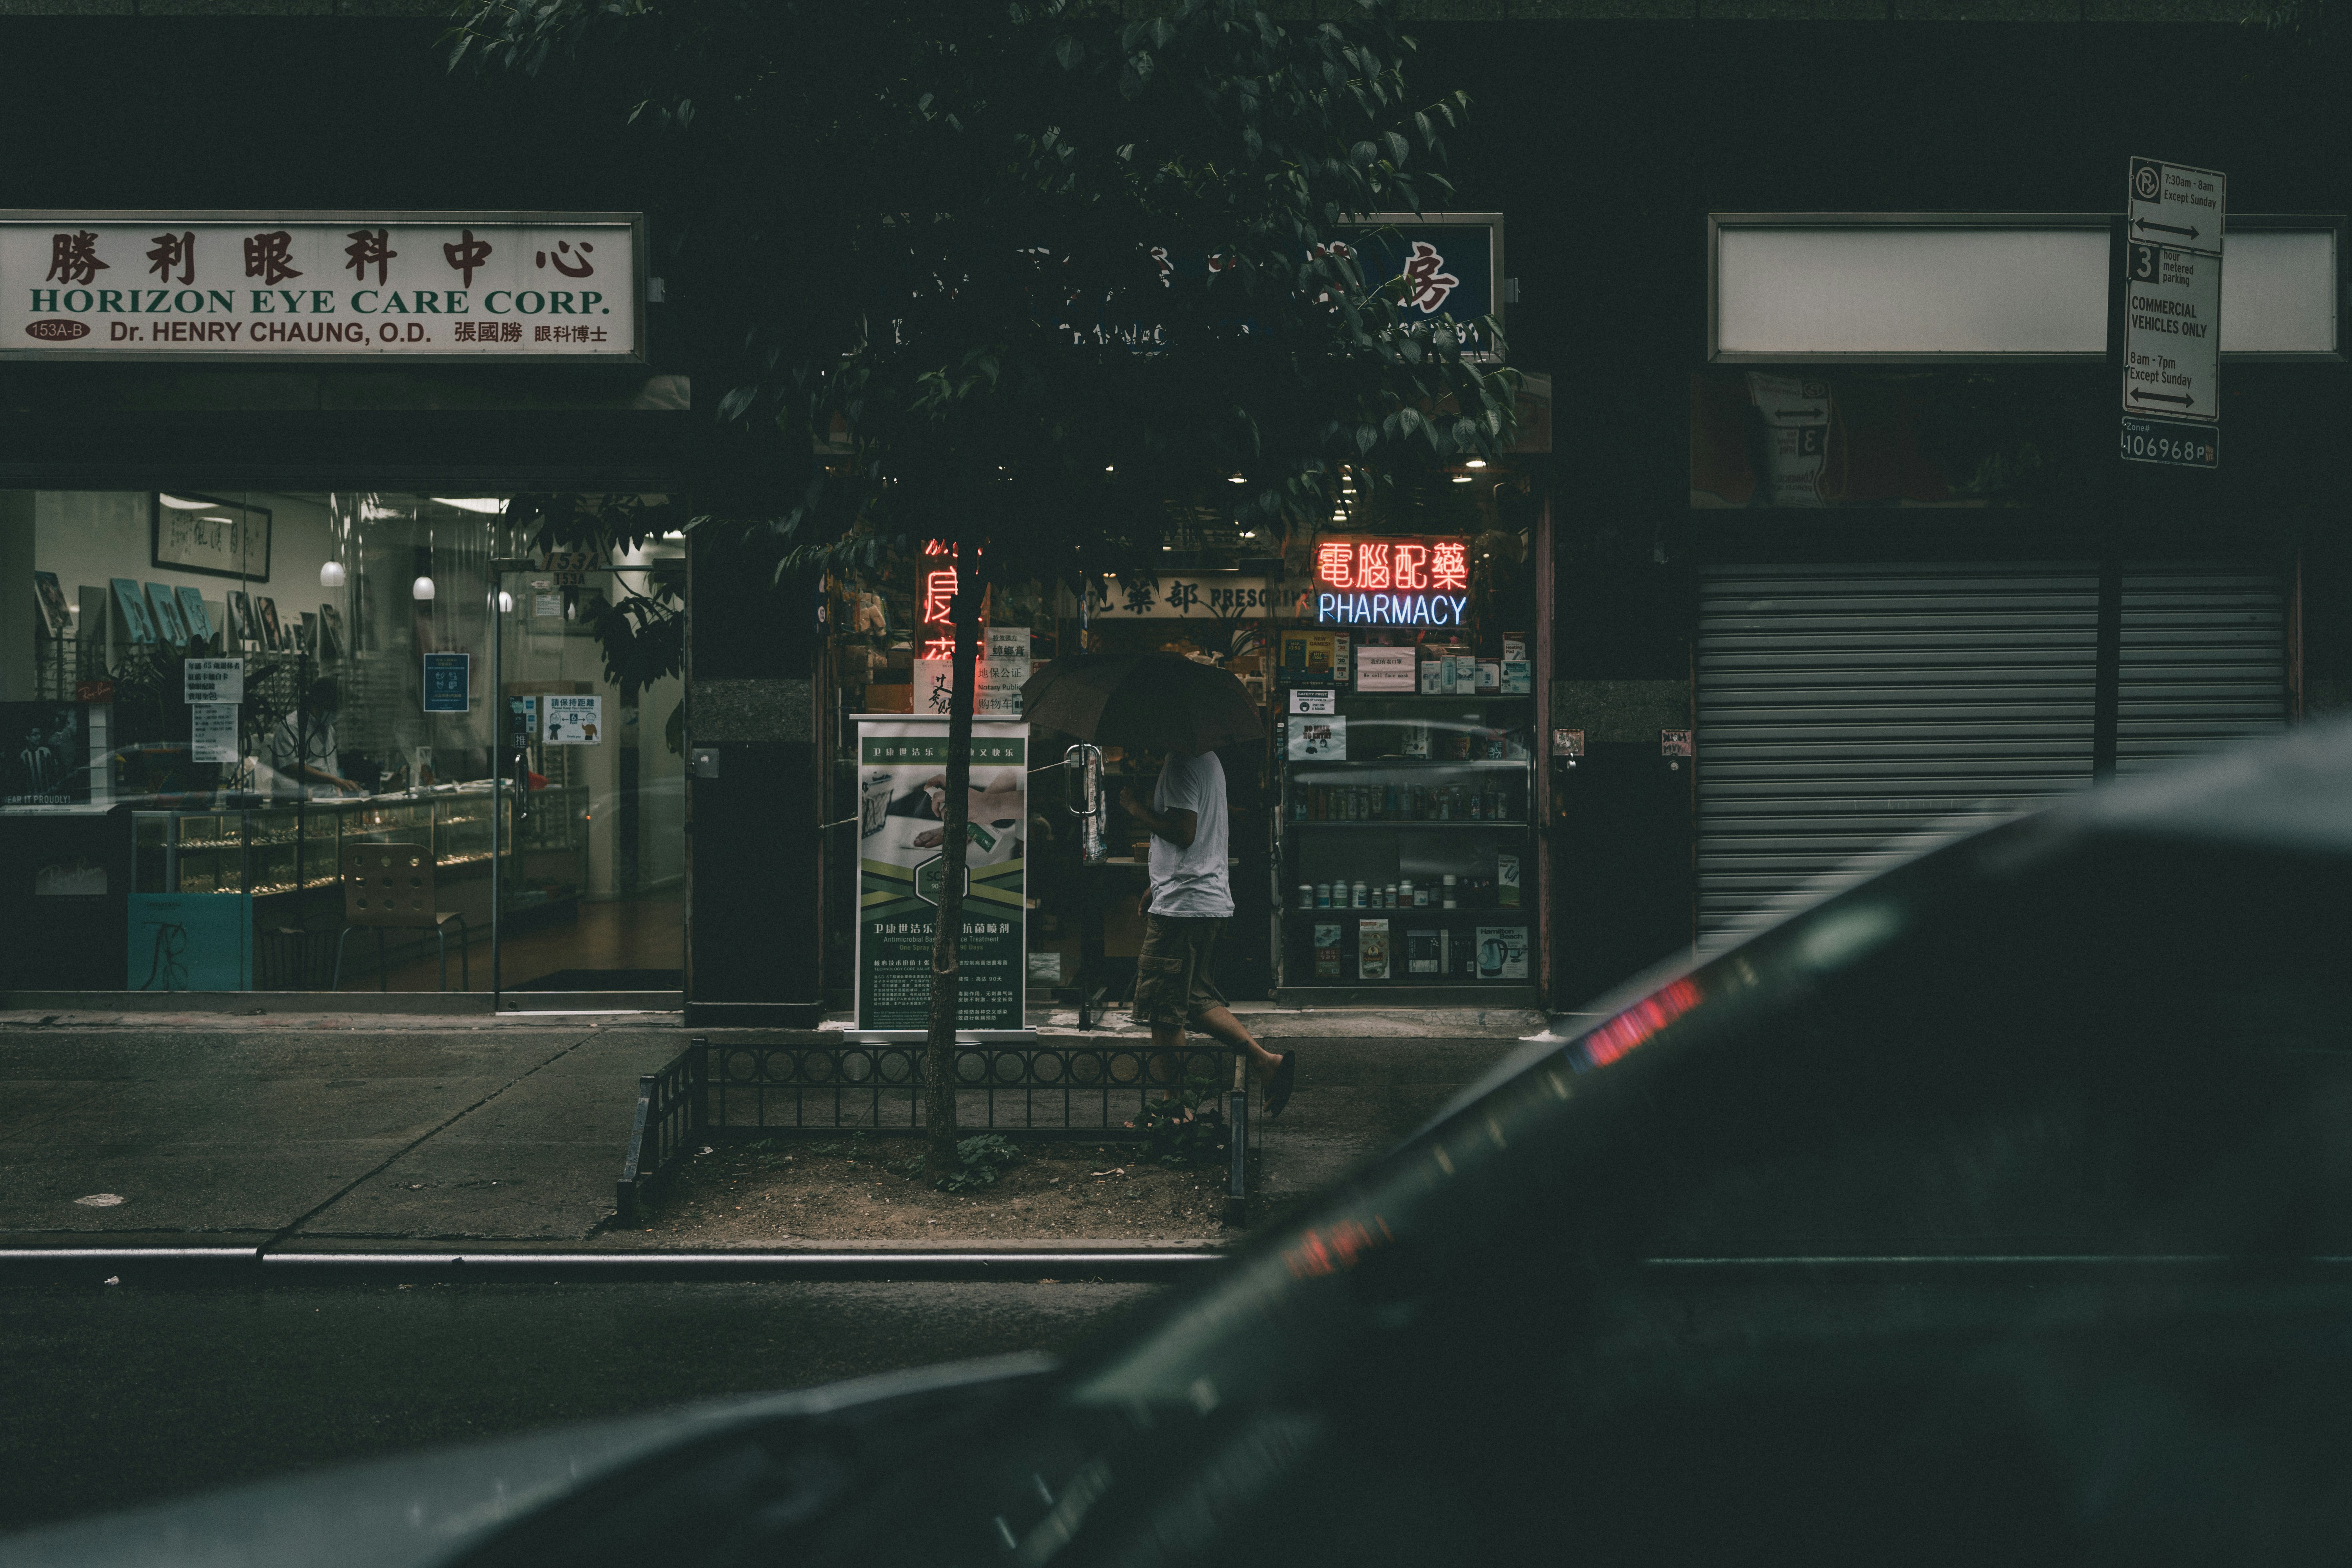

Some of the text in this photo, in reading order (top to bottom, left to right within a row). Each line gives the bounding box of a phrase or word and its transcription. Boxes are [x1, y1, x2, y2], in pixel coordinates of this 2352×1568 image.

[2165, 174, 2191, 188] 7:30am
[2198, 180, 2214, 192] 8am
[2164, 189, 2216, 209] Except Sunday
[46, 229, 593, 289] 勝利眼科中心
[2137, 247, 2151, 278] 3
[2163, 250, 2180, 261] hour
[2163, 262, 2194, 275] metered
[2163, 273, 2190, 287] parking
[29, 289, 610, 314] HORIZON EYE CARE CORP.
[2132, 296, 2197, 319] COMMERCIAL
[32, 323, 83, 336] 153A-B
[111, 322, 431, 346] Dr. HENRY CHAUNG, O.D.
[454, 321, 607, 343] 張國勝 眼科博士
[2132, 314, 2207, 338] VEHICLES ONLY
[2158, 355, 2176, 370] 7pm
[2130, 367, 2192, 389] Except Sunday
[2126, 422, 2150, 432] Zone#
[545, 553, 599, 570] 153A
[1319, 543, 1467, 590] 電腦配藥
[555, 573, 585, 584] 153A
[1318, 593, 1466, 625] PHARMACY
[993, 645, 1025, 655] 蟑螂膏
[551, 698, 594, 706] 請保持距離
[515, 735, 526, 745] 推
[873, 748, 934, 757] 卫康世洁乐
[24, 795, 31, 804] IT
[34, 795, 71, 804] PROUDLY!
[963, 923, 1010, 934] 抗菌喷剂
